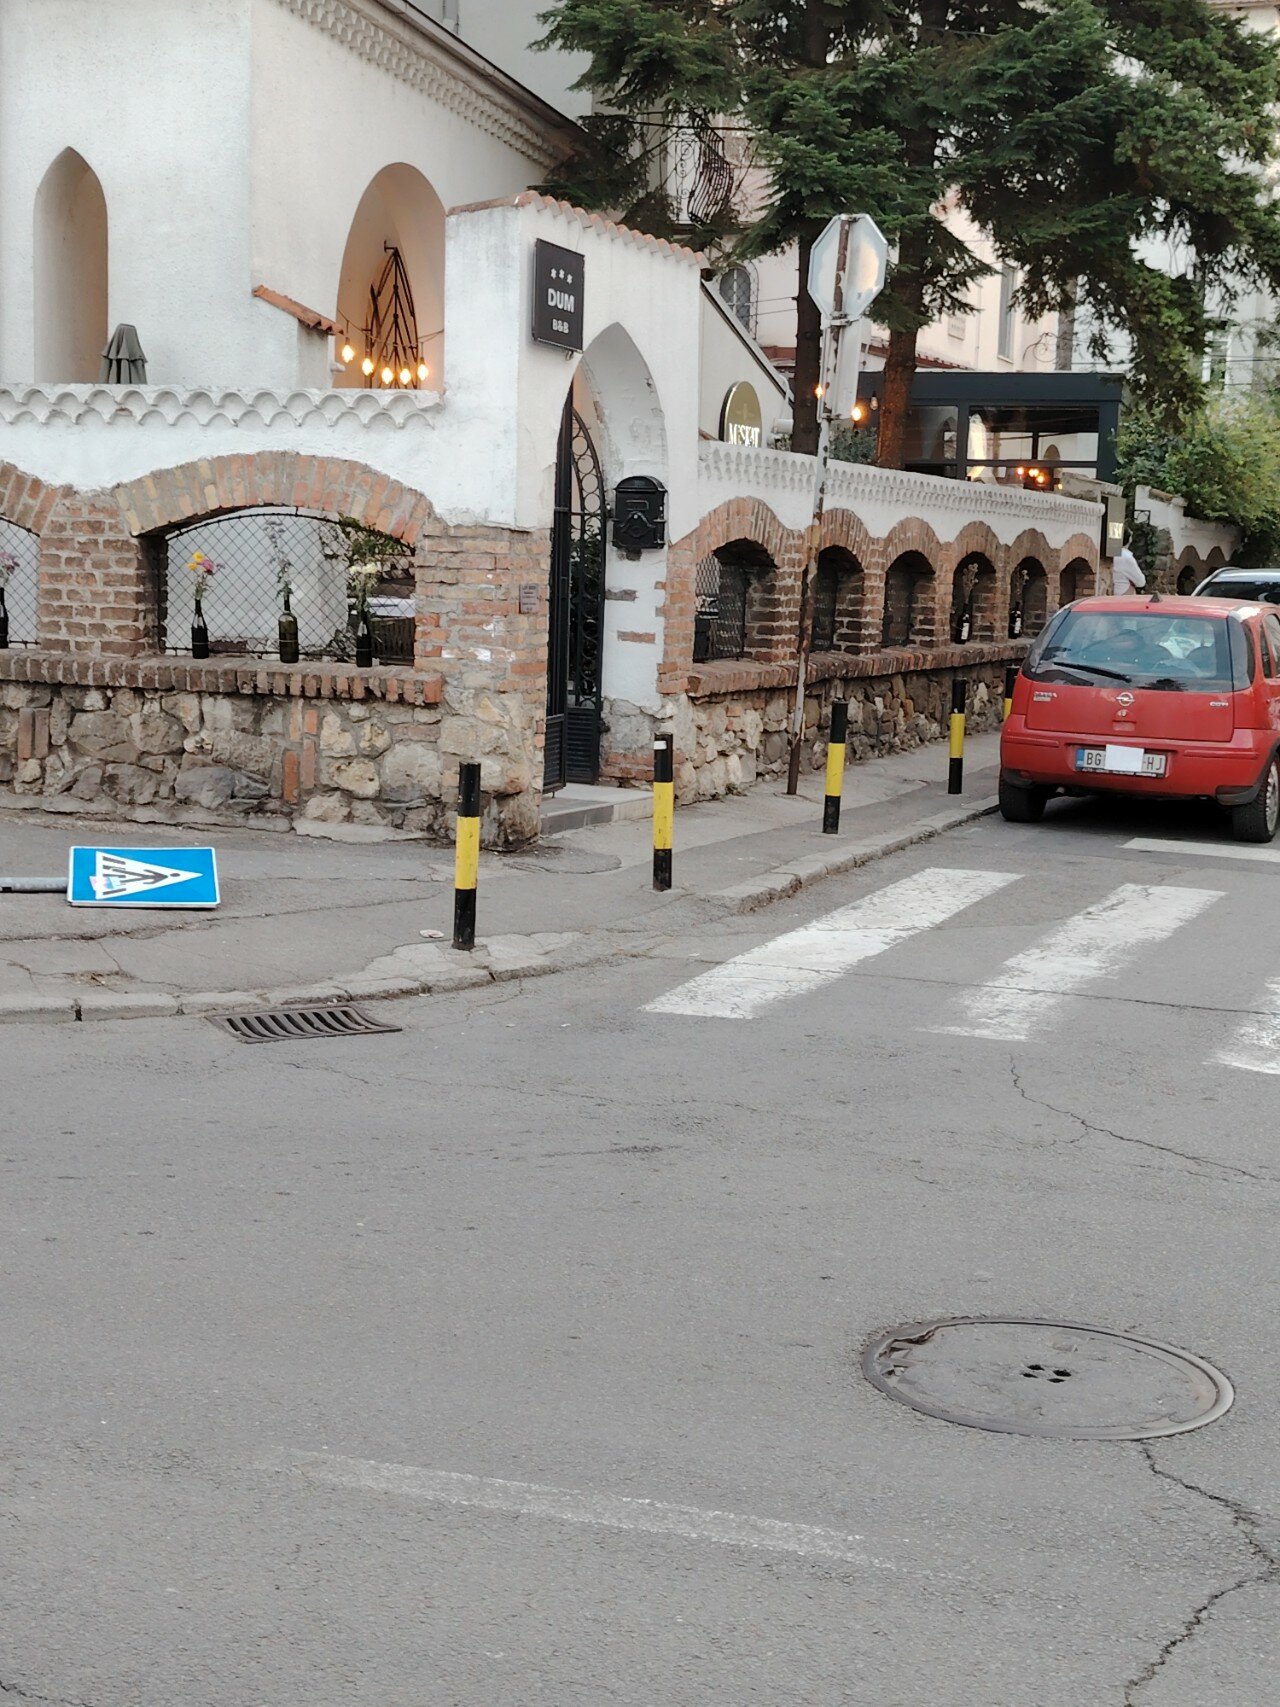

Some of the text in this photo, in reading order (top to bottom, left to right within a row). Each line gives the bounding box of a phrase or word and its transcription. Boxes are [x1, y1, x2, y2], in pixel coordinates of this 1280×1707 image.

[547, 287, 575, 313] DUM
[552, 318, 569, 334] B&B
[1086, 752, 1102, 766] BG
